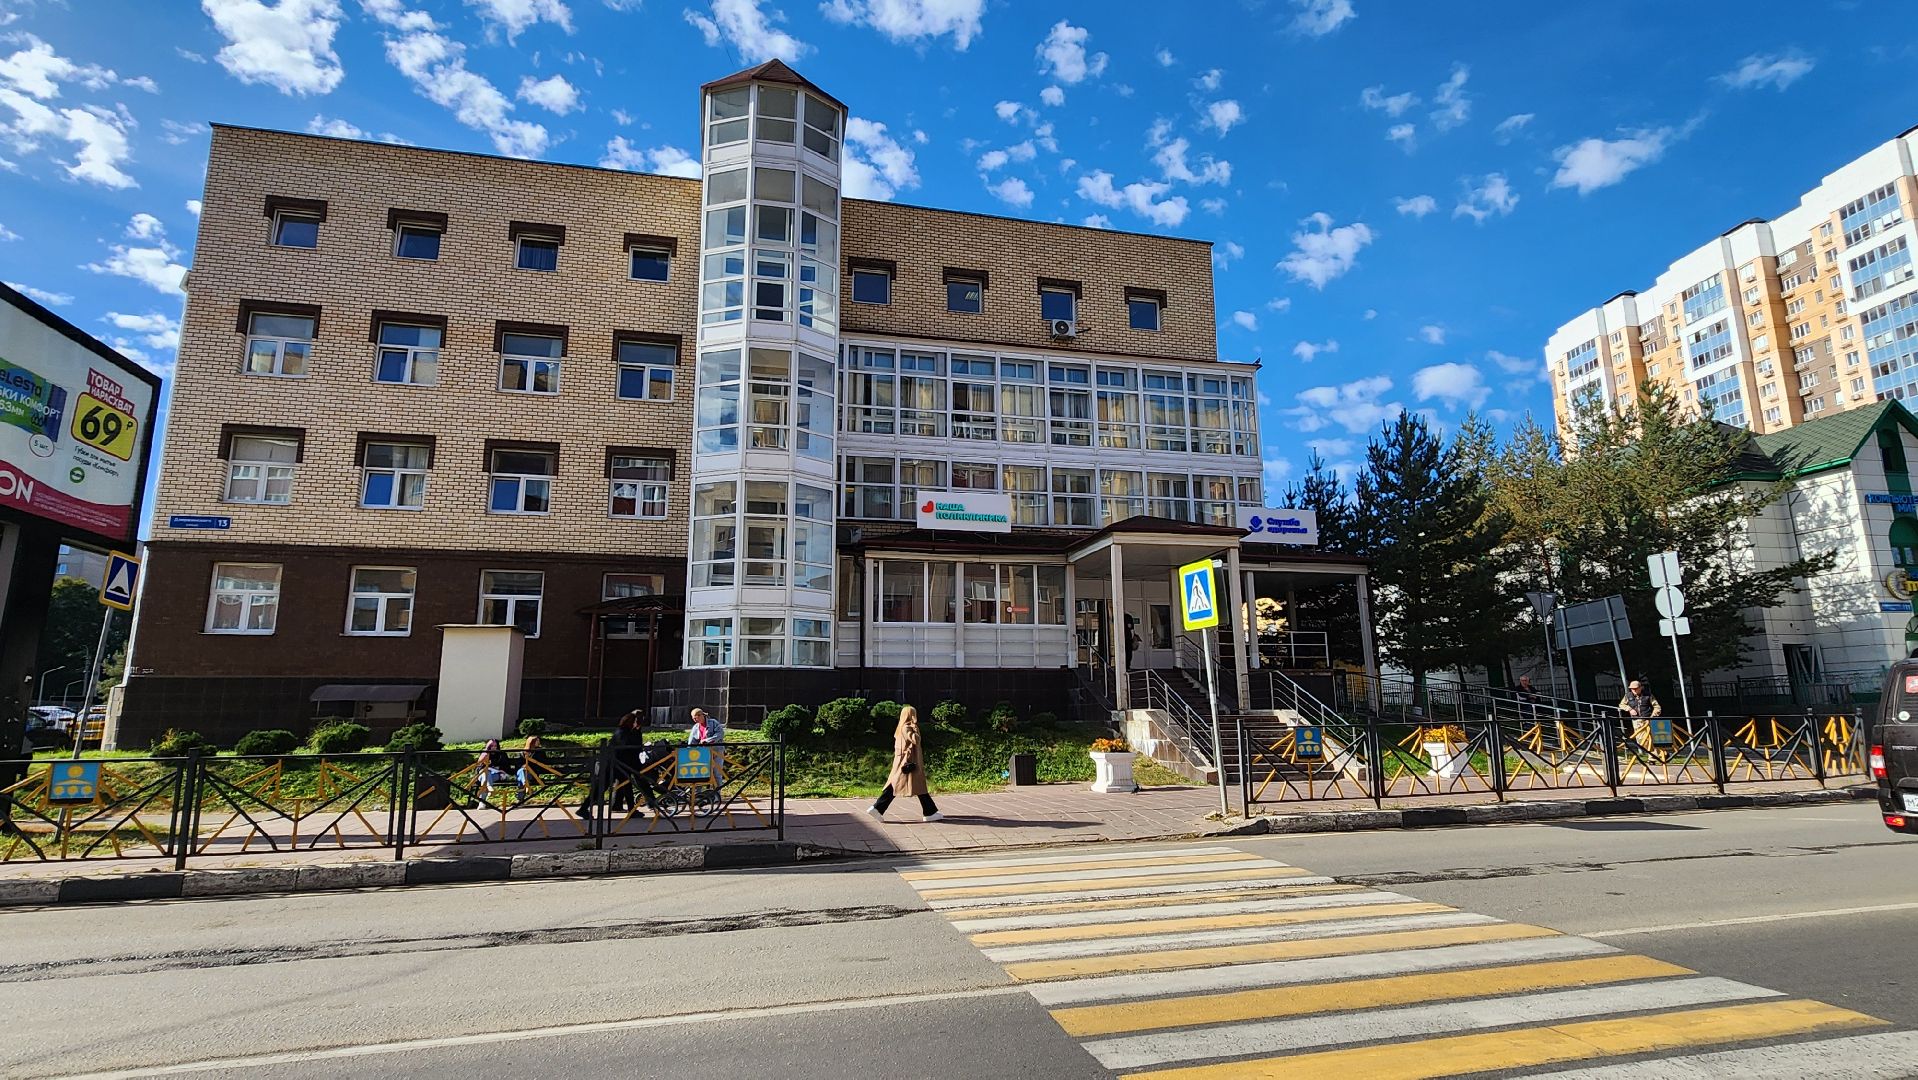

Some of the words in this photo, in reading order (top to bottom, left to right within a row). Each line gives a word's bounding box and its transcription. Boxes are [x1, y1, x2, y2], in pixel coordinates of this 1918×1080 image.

[90, 371, 120, 396] ТОВАР
[19, 394, 61, 420] КОМФОРТ
[91, 386, 132, 414] НАРАСХВАТ
[81, 405, 122, 446] 69
[936, 502, 965, 511] НАША
[936, 512, 1006, 522] ПОЛИКЛИНИКА
